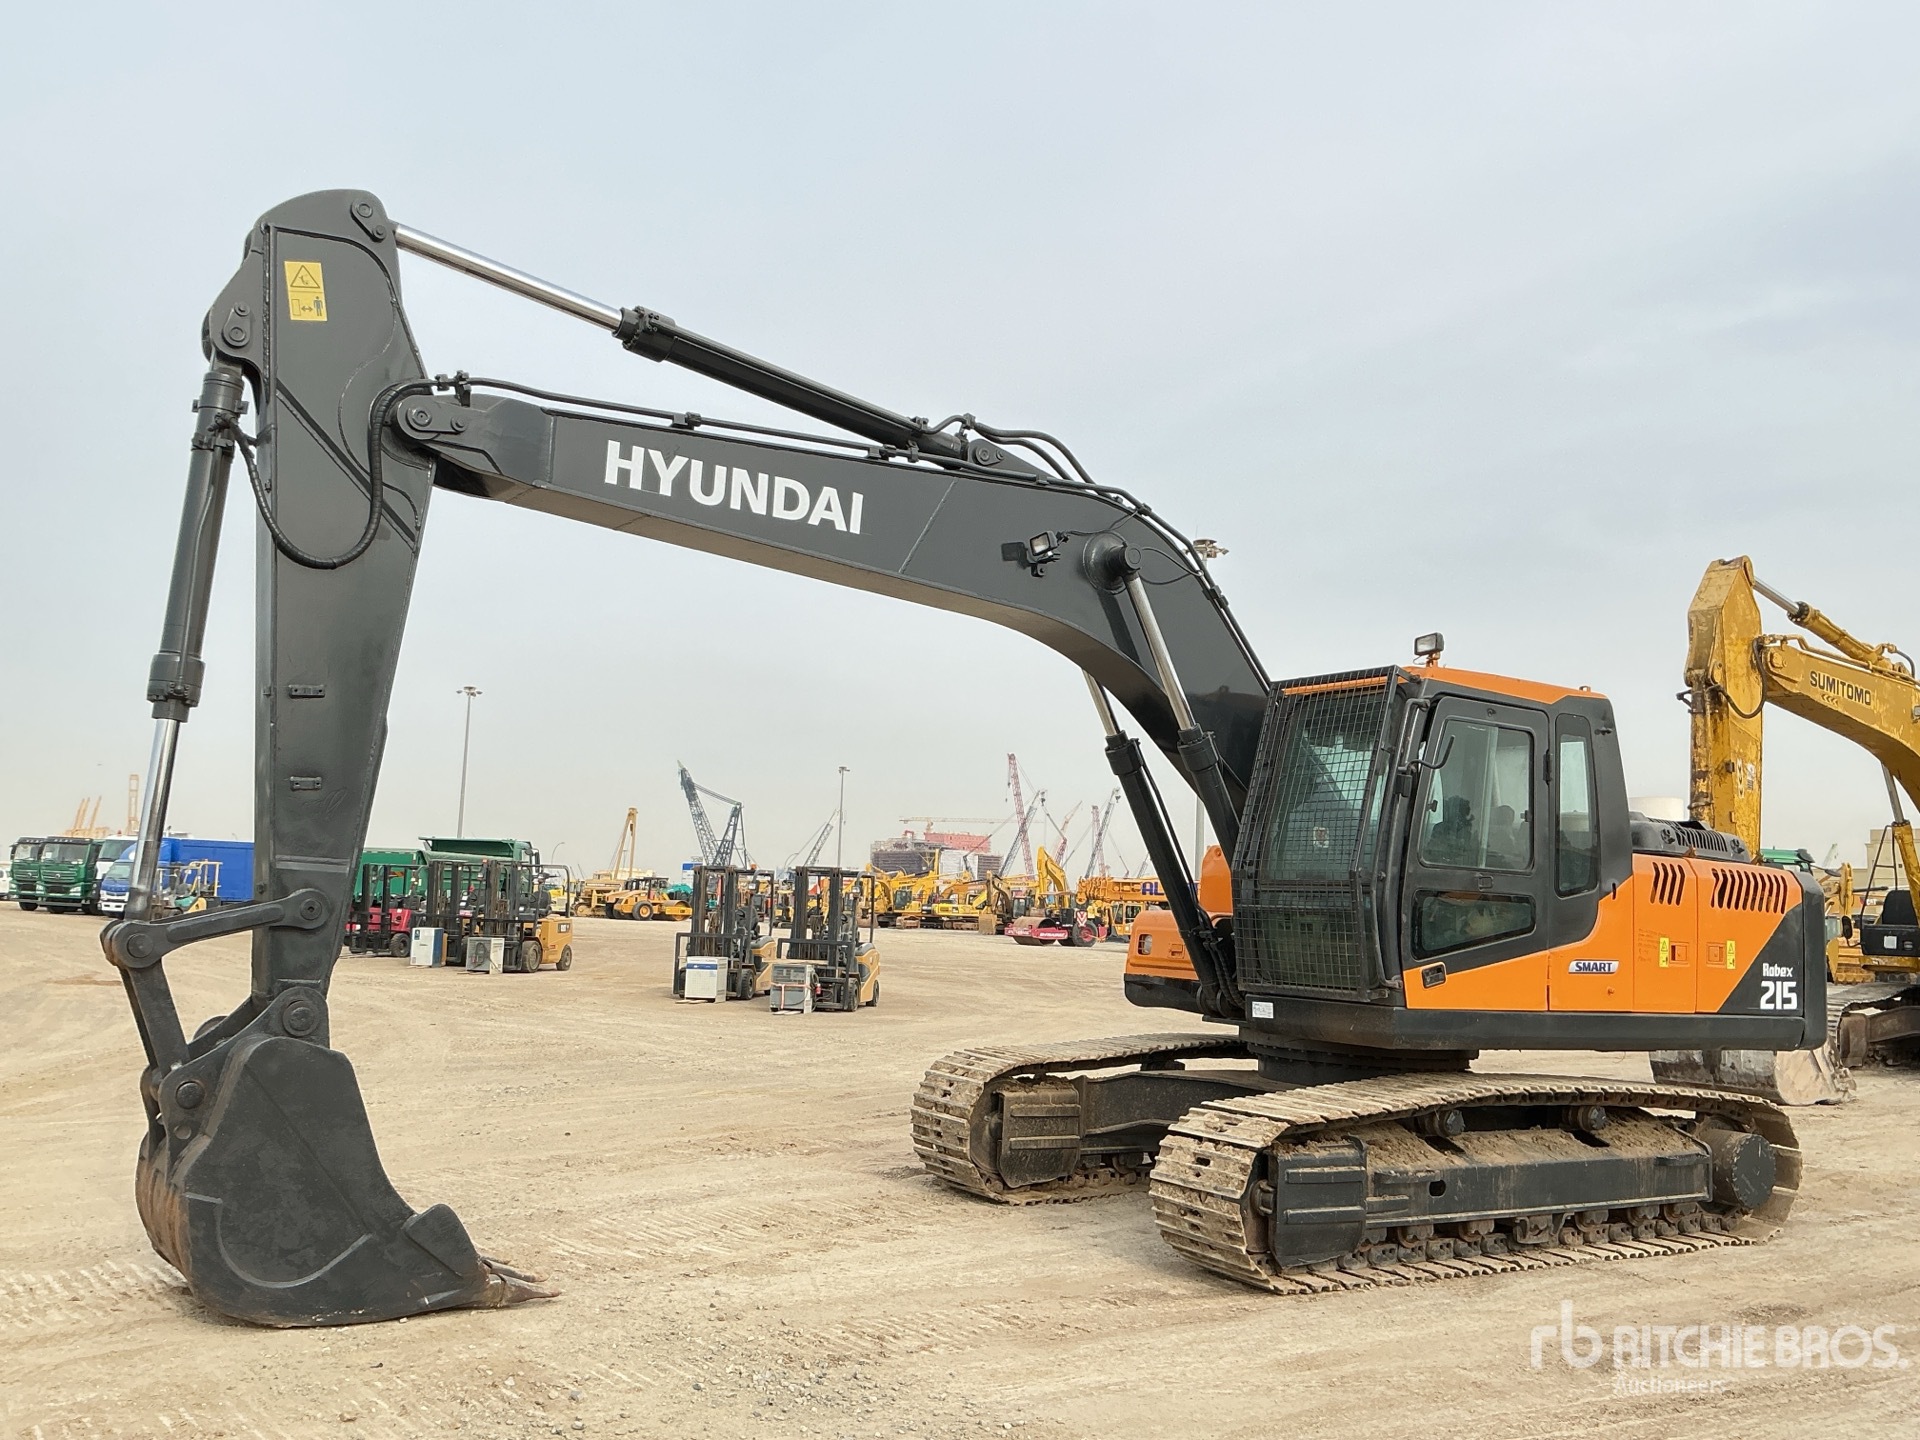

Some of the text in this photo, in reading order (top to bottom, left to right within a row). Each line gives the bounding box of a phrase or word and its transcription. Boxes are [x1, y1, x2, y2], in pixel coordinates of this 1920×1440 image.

[604, 439, 864, 535] HYUNDAI
[1809, 670, 1872, 706] SUMITOMO
[1575, 961, 1613, 972] SMART
[1762, 962, 1794, 978] Robex
[1760, 980, 1798, 1010] 215
